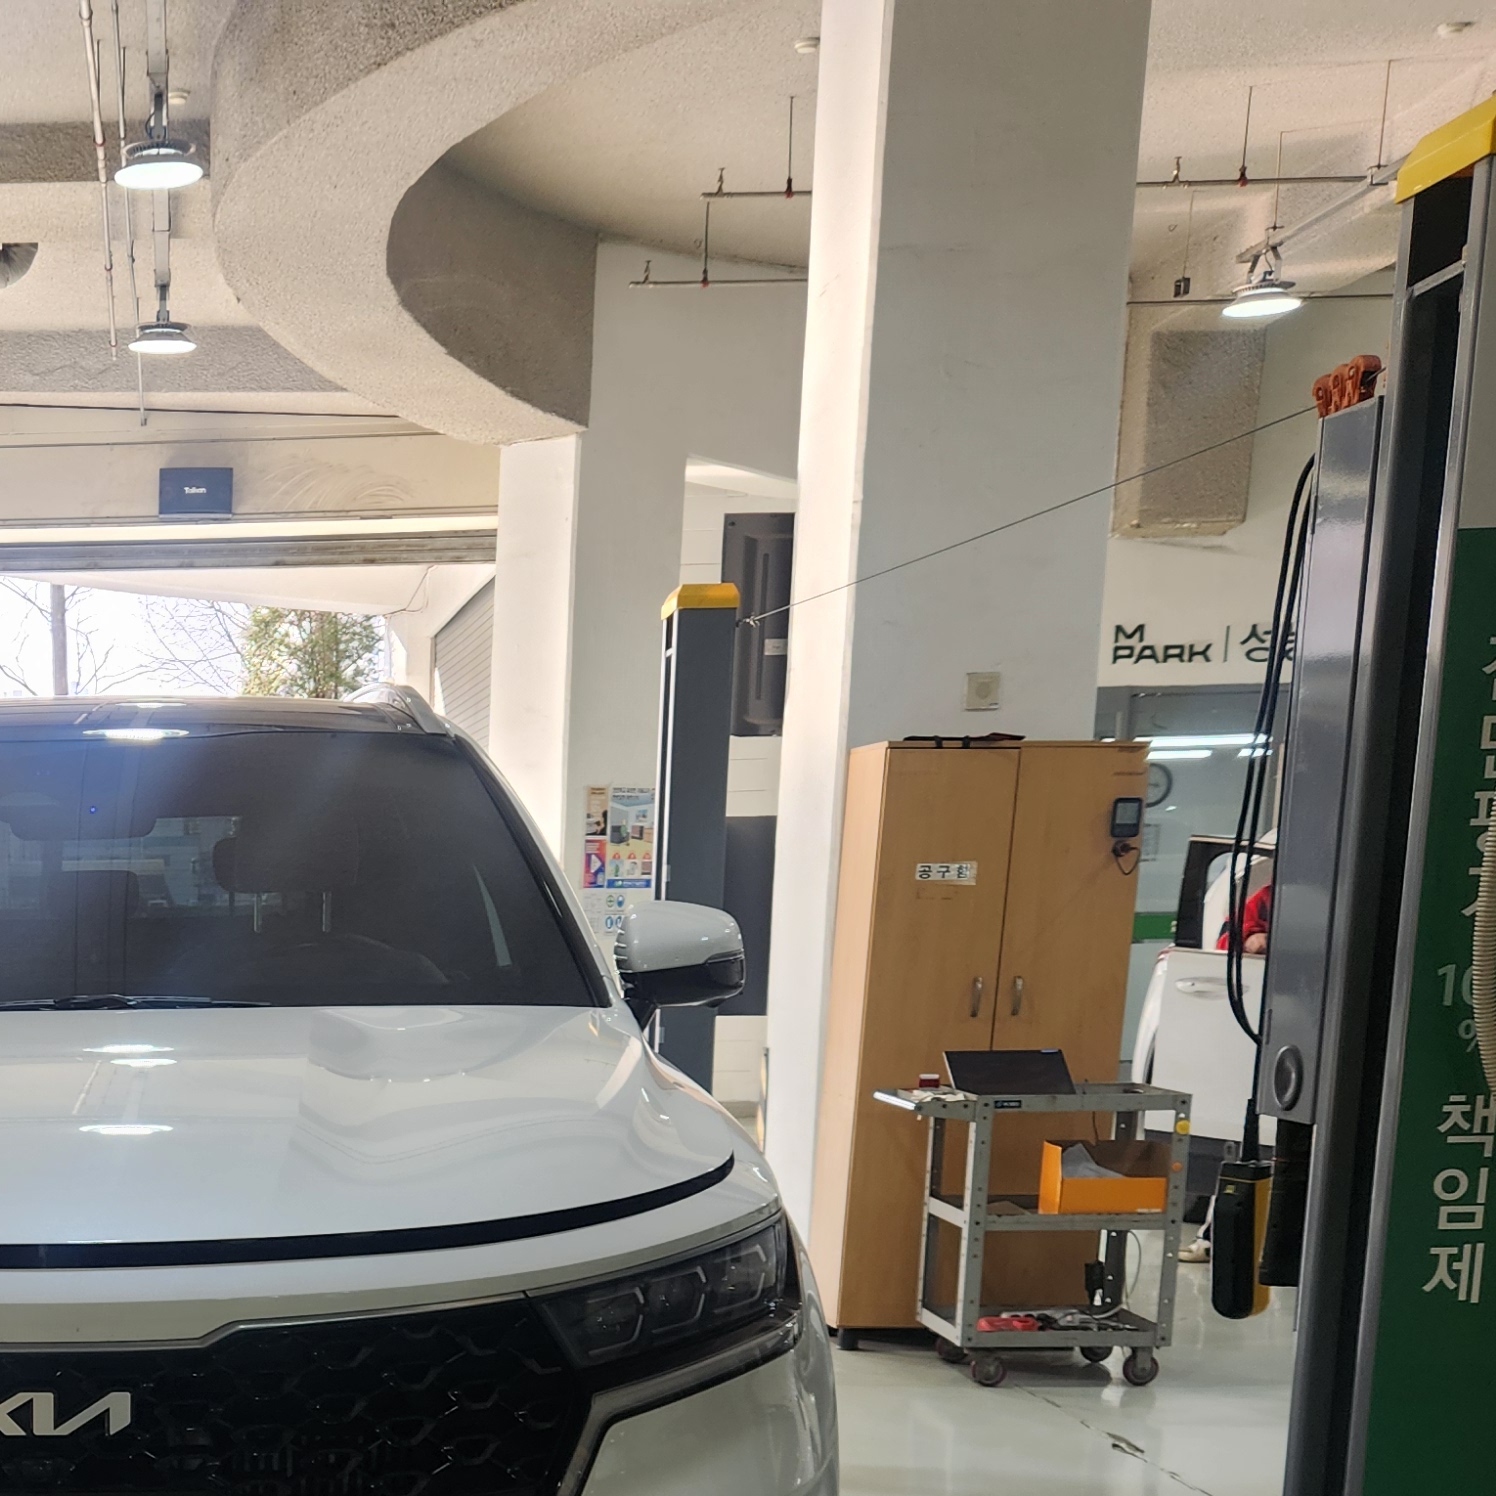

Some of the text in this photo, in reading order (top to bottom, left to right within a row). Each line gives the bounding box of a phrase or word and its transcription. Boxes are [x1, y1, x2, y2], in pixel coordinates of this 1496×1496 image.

[1114, 624, 1146, 644] M
[1112, 643, 1213, 664] PARK
[918, 864, 969, 879] 공구함
[1422, 1093, 1496, 1304] 책임제
